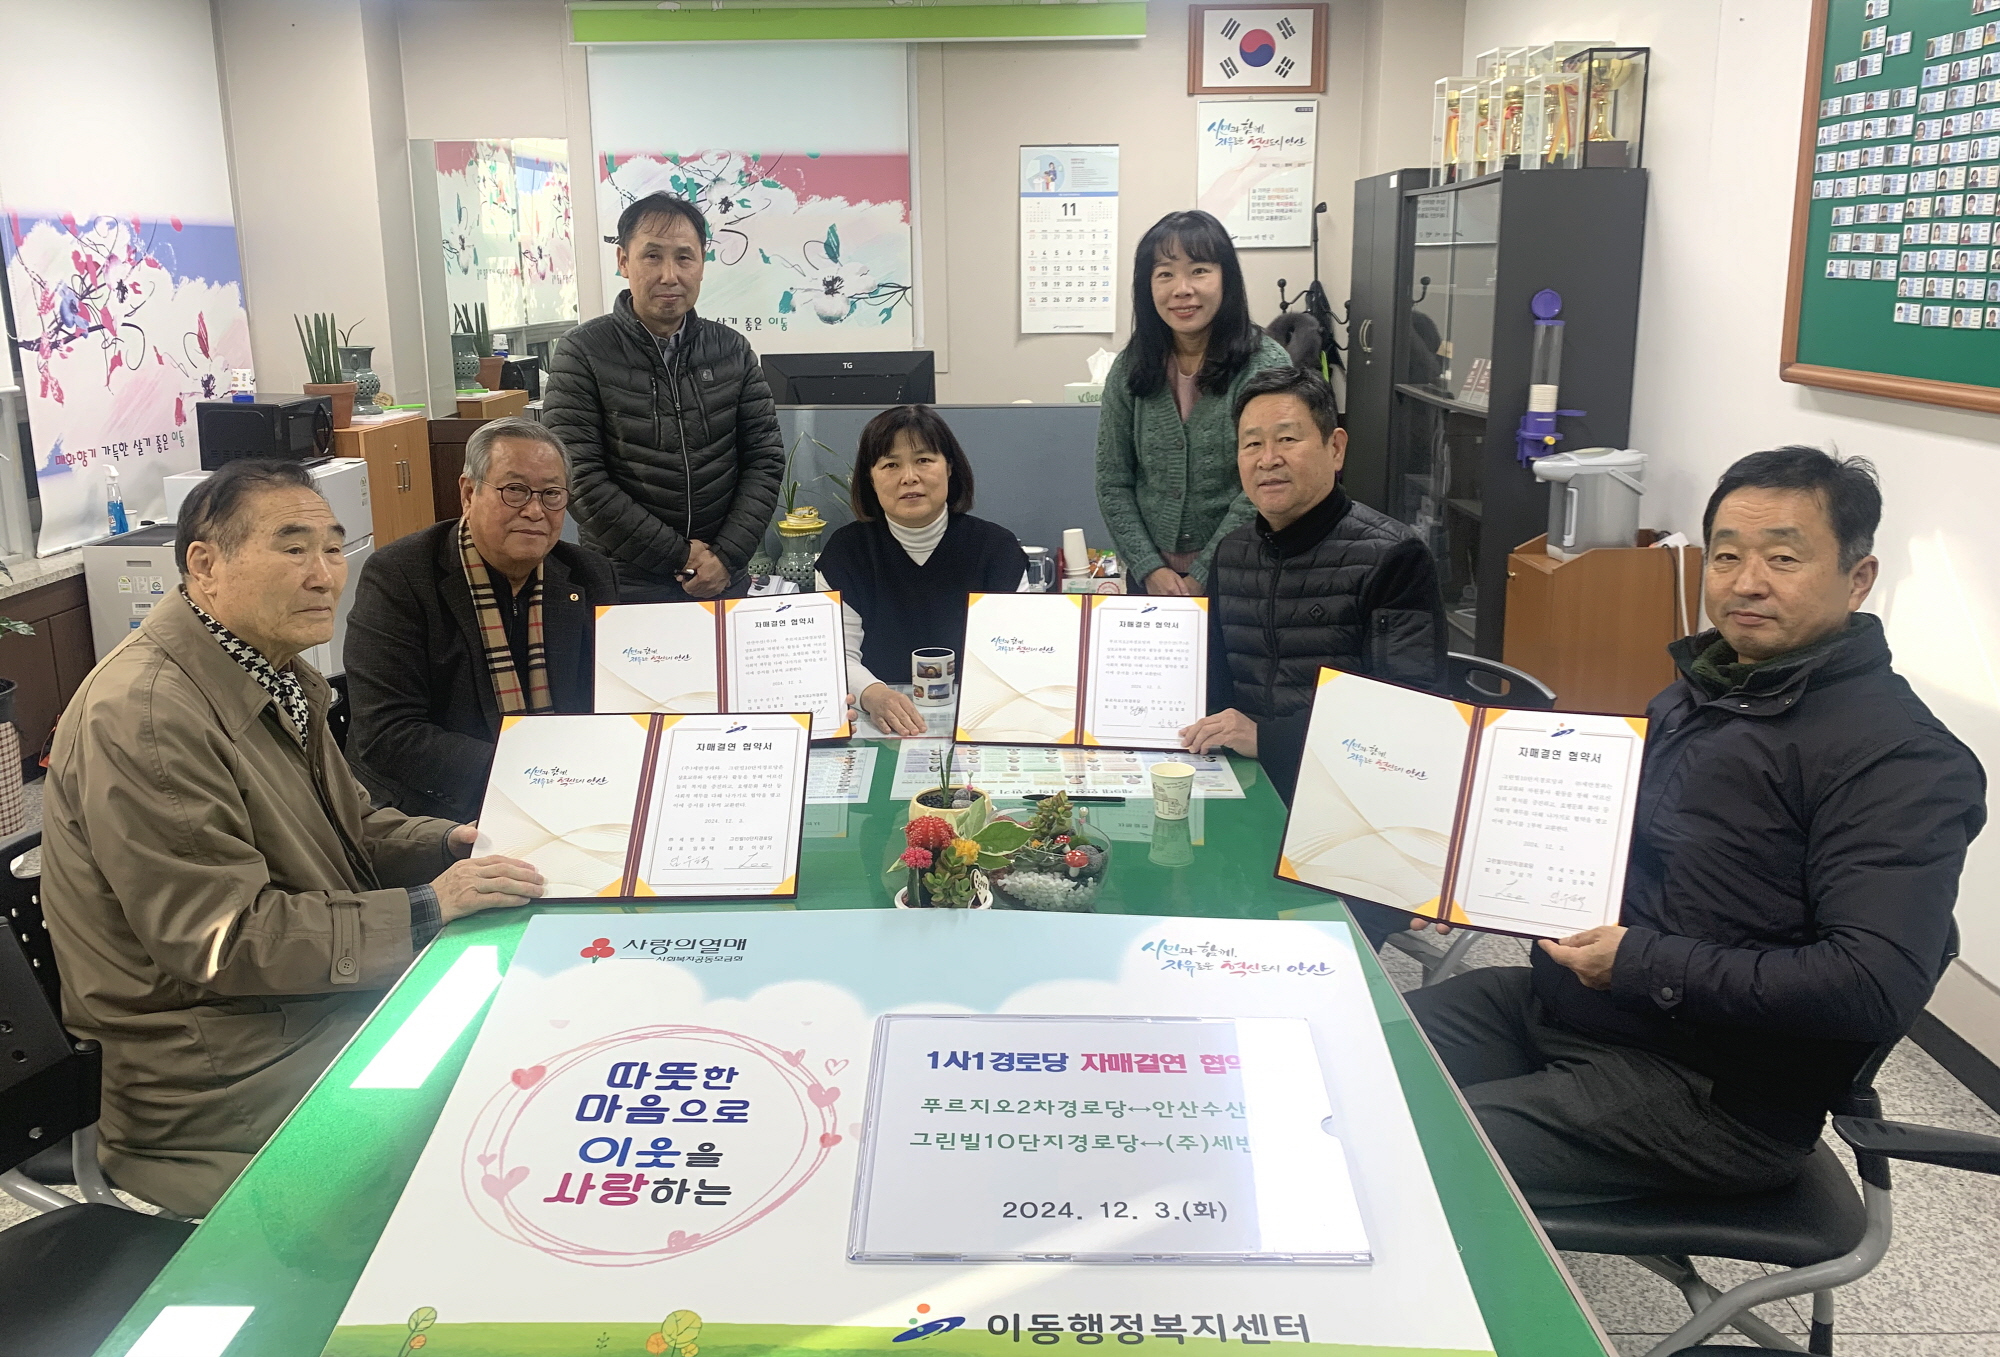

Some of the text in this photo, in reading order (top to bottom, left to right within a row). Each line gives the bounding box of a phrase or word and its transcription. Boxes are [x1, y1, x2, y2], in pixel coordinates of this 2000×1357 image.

[1207, 118, 1242, 139] 시민과
[1215, 136, 1308, 153] 자유로운 혁신도시 안산
[1062, 203, 1076, 216] 11
[745, 317, 762, 331] 좋은
[769, 317, 787, 332] 이동
[55, 430, 185, 467] 매화향기 가득한 살기 좋은 이동
[755, 616, 814, 628] 자매결연 협약서
[1119, 620, 1179, 629] 자매결연 협약서
[696, 742, 773, 752] 자매결연 협약서
[1518, 746, 1603, 764] 자매결연 협약서
[587, 777, 609, 786] 안산
[1406, 768, 1428, 780] 안산
[623, 939, 747, 955] 사랑의열매
[1141, 939, 1198, 960] 시민과
[656, 956, 743, 964] 사회복지공동모금회
[1160, 960, 1336, 978] 자유로운 혁신도시 안산
[926, 1051, 1069, 1073] 1사1경로당
[1080, 1051, 1188, 1074] 자매결연
[606, 1061, 739, 1091] 따뜻한
[575, 1093, 750, 1125] 마음으로
[579, 1136, 723, 1169] 이웃을
[543, 1172, 732, 1206] 사랑하는
[1002, 1201, 1228, 1223] 2024. 12. 3.(화)
[987, 1312, 1313, 1346] 이동행정복지센터
